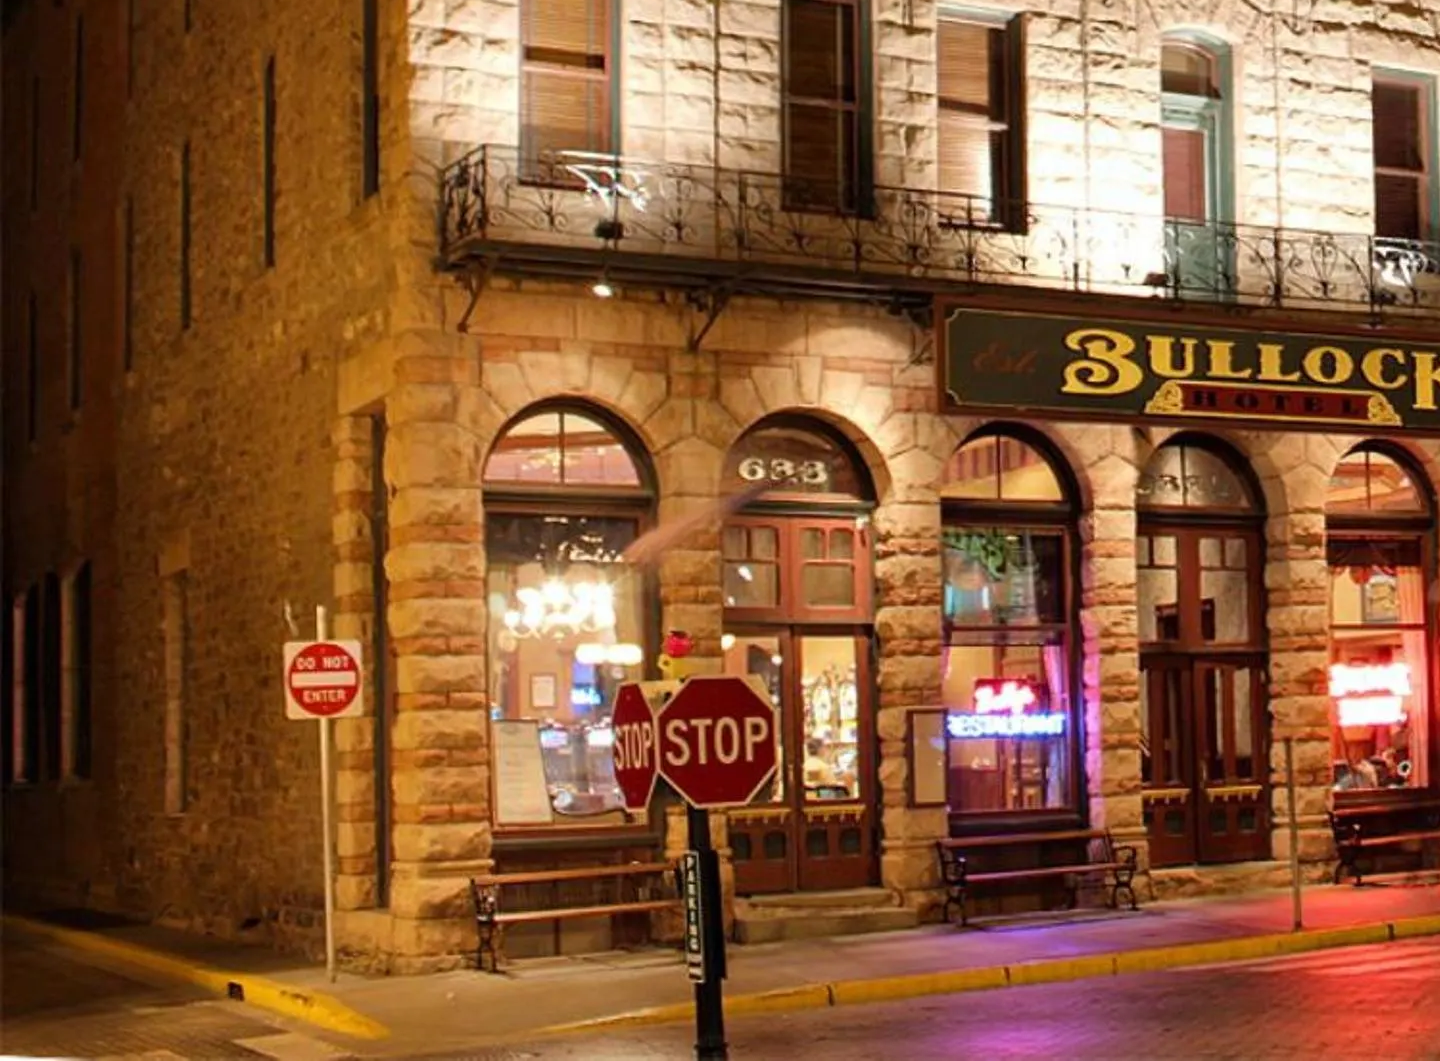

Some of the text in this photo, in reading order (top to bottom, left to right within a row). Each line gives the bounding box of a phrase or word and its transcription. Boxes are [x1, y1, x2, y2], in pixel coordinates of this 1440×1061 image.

[1193, 389, 1360, 416] HOTEL
[739, 458, 828, 483] 633
[295, 656, 348, 670] DO NOT
[303, 689, 346, 704] ENTER
[615, 721, 653, 771] STOP
[665, 716, 769, 766] STOP
